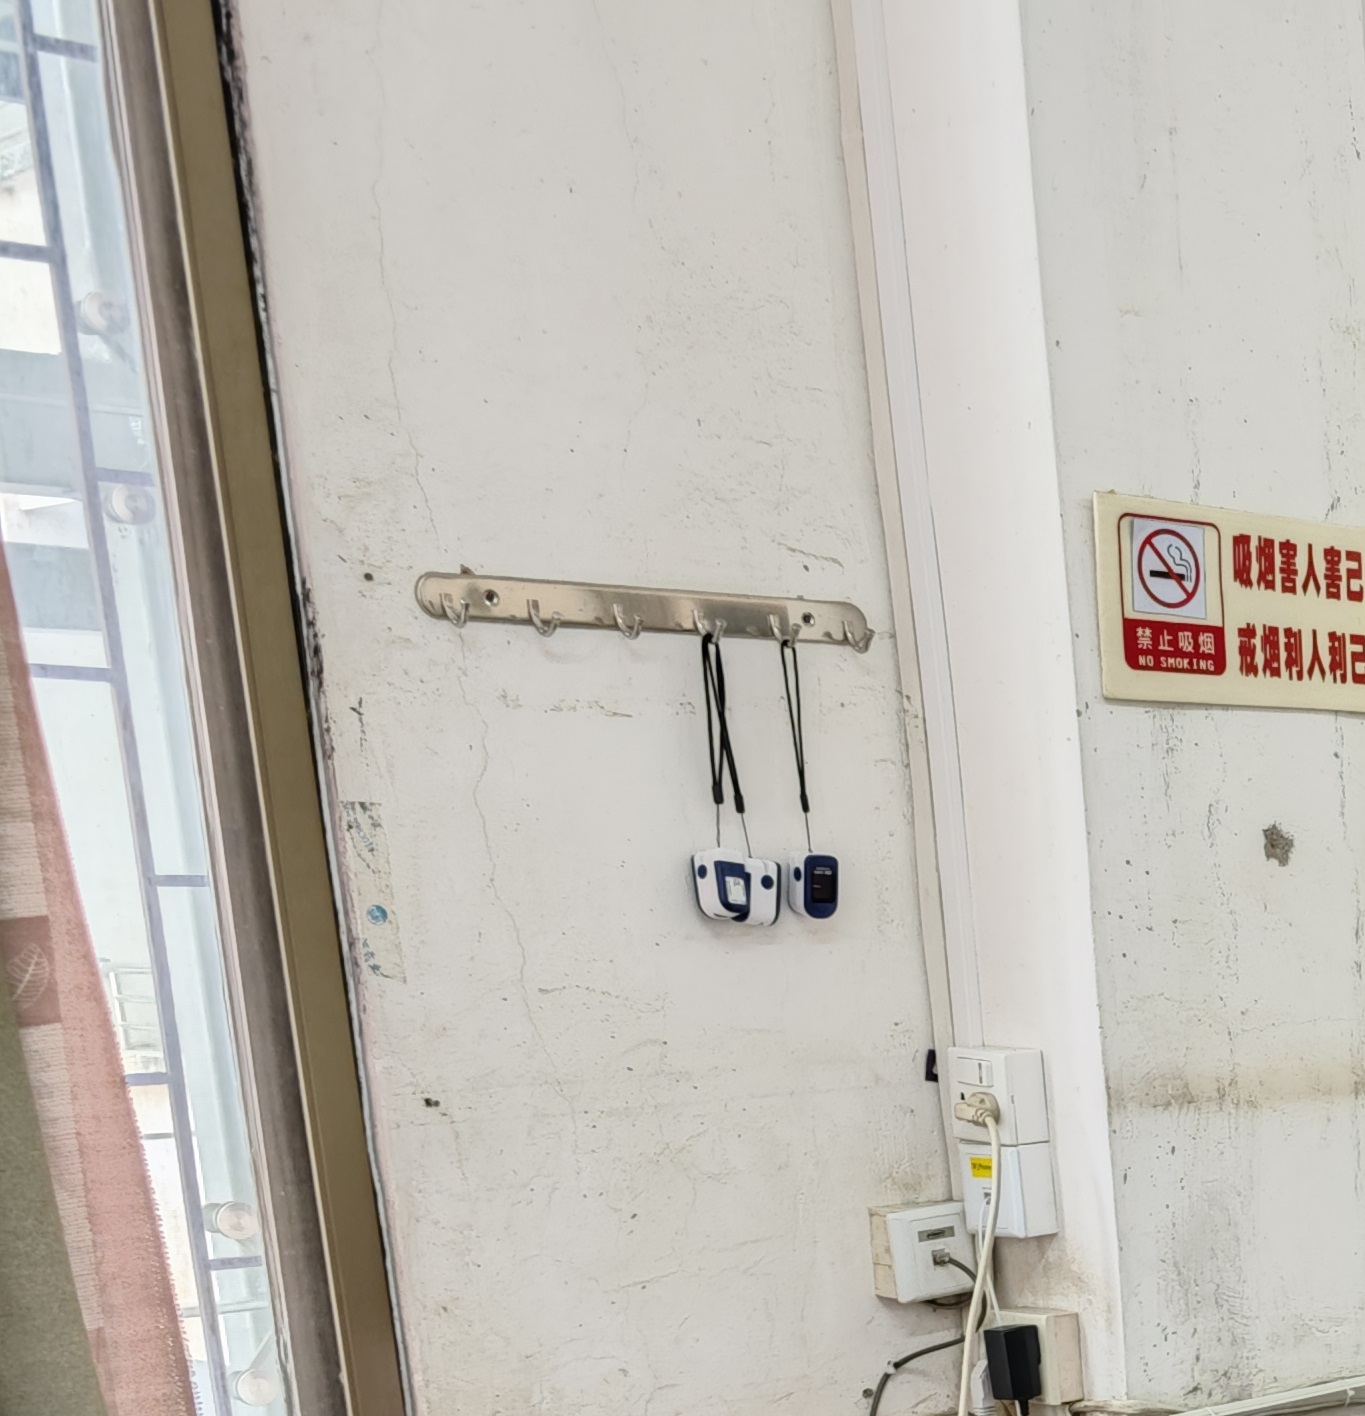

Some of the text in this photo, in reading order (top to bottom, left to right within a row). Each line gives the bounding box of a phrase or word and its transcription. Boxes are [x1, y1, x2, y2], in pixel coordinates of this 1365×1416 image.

[1232, 533, 1364, 603] 吸烟害人害己
[1136, 627, 1215, 654] 禁止吸烟
[1138, 655, 1215, 672] NO SMOKING
